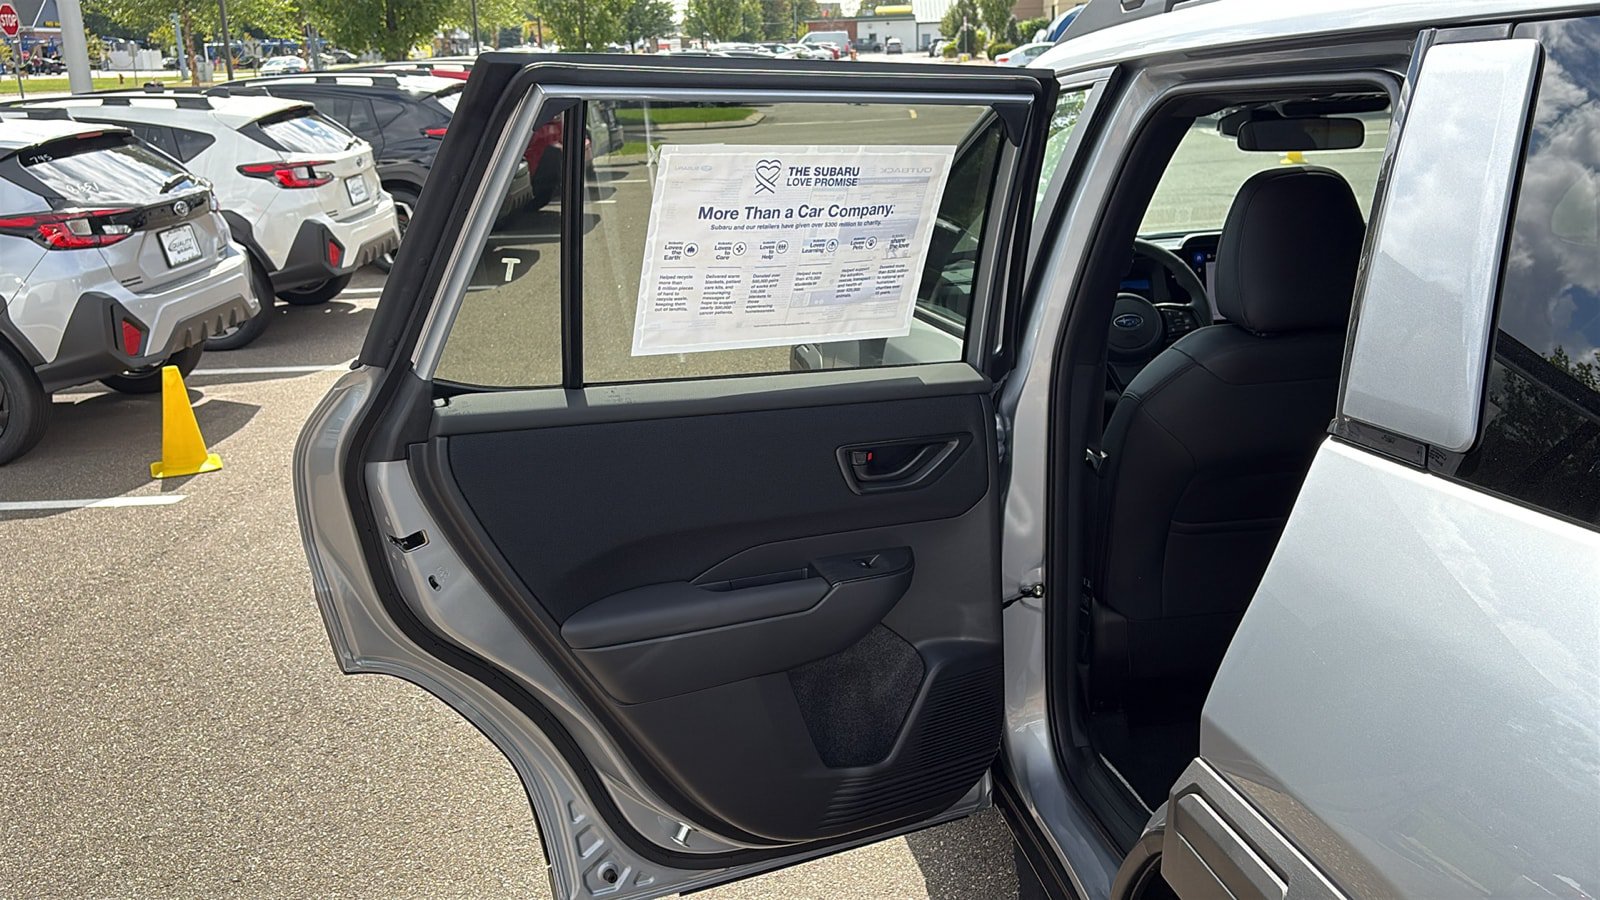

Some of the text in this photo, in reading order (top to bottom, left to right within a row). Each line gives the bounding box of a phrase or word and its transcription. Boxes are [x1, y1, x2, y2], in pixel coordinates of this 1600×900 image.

[0, 14, 17, 27] STOP
[788, 166, 860, 176] THE SUBARU
[786, 177, 858, 187] LOVE PROMISE
[698, 204, 894, 220] More Than a Car Company.
[795, 222, 810, 230] given
